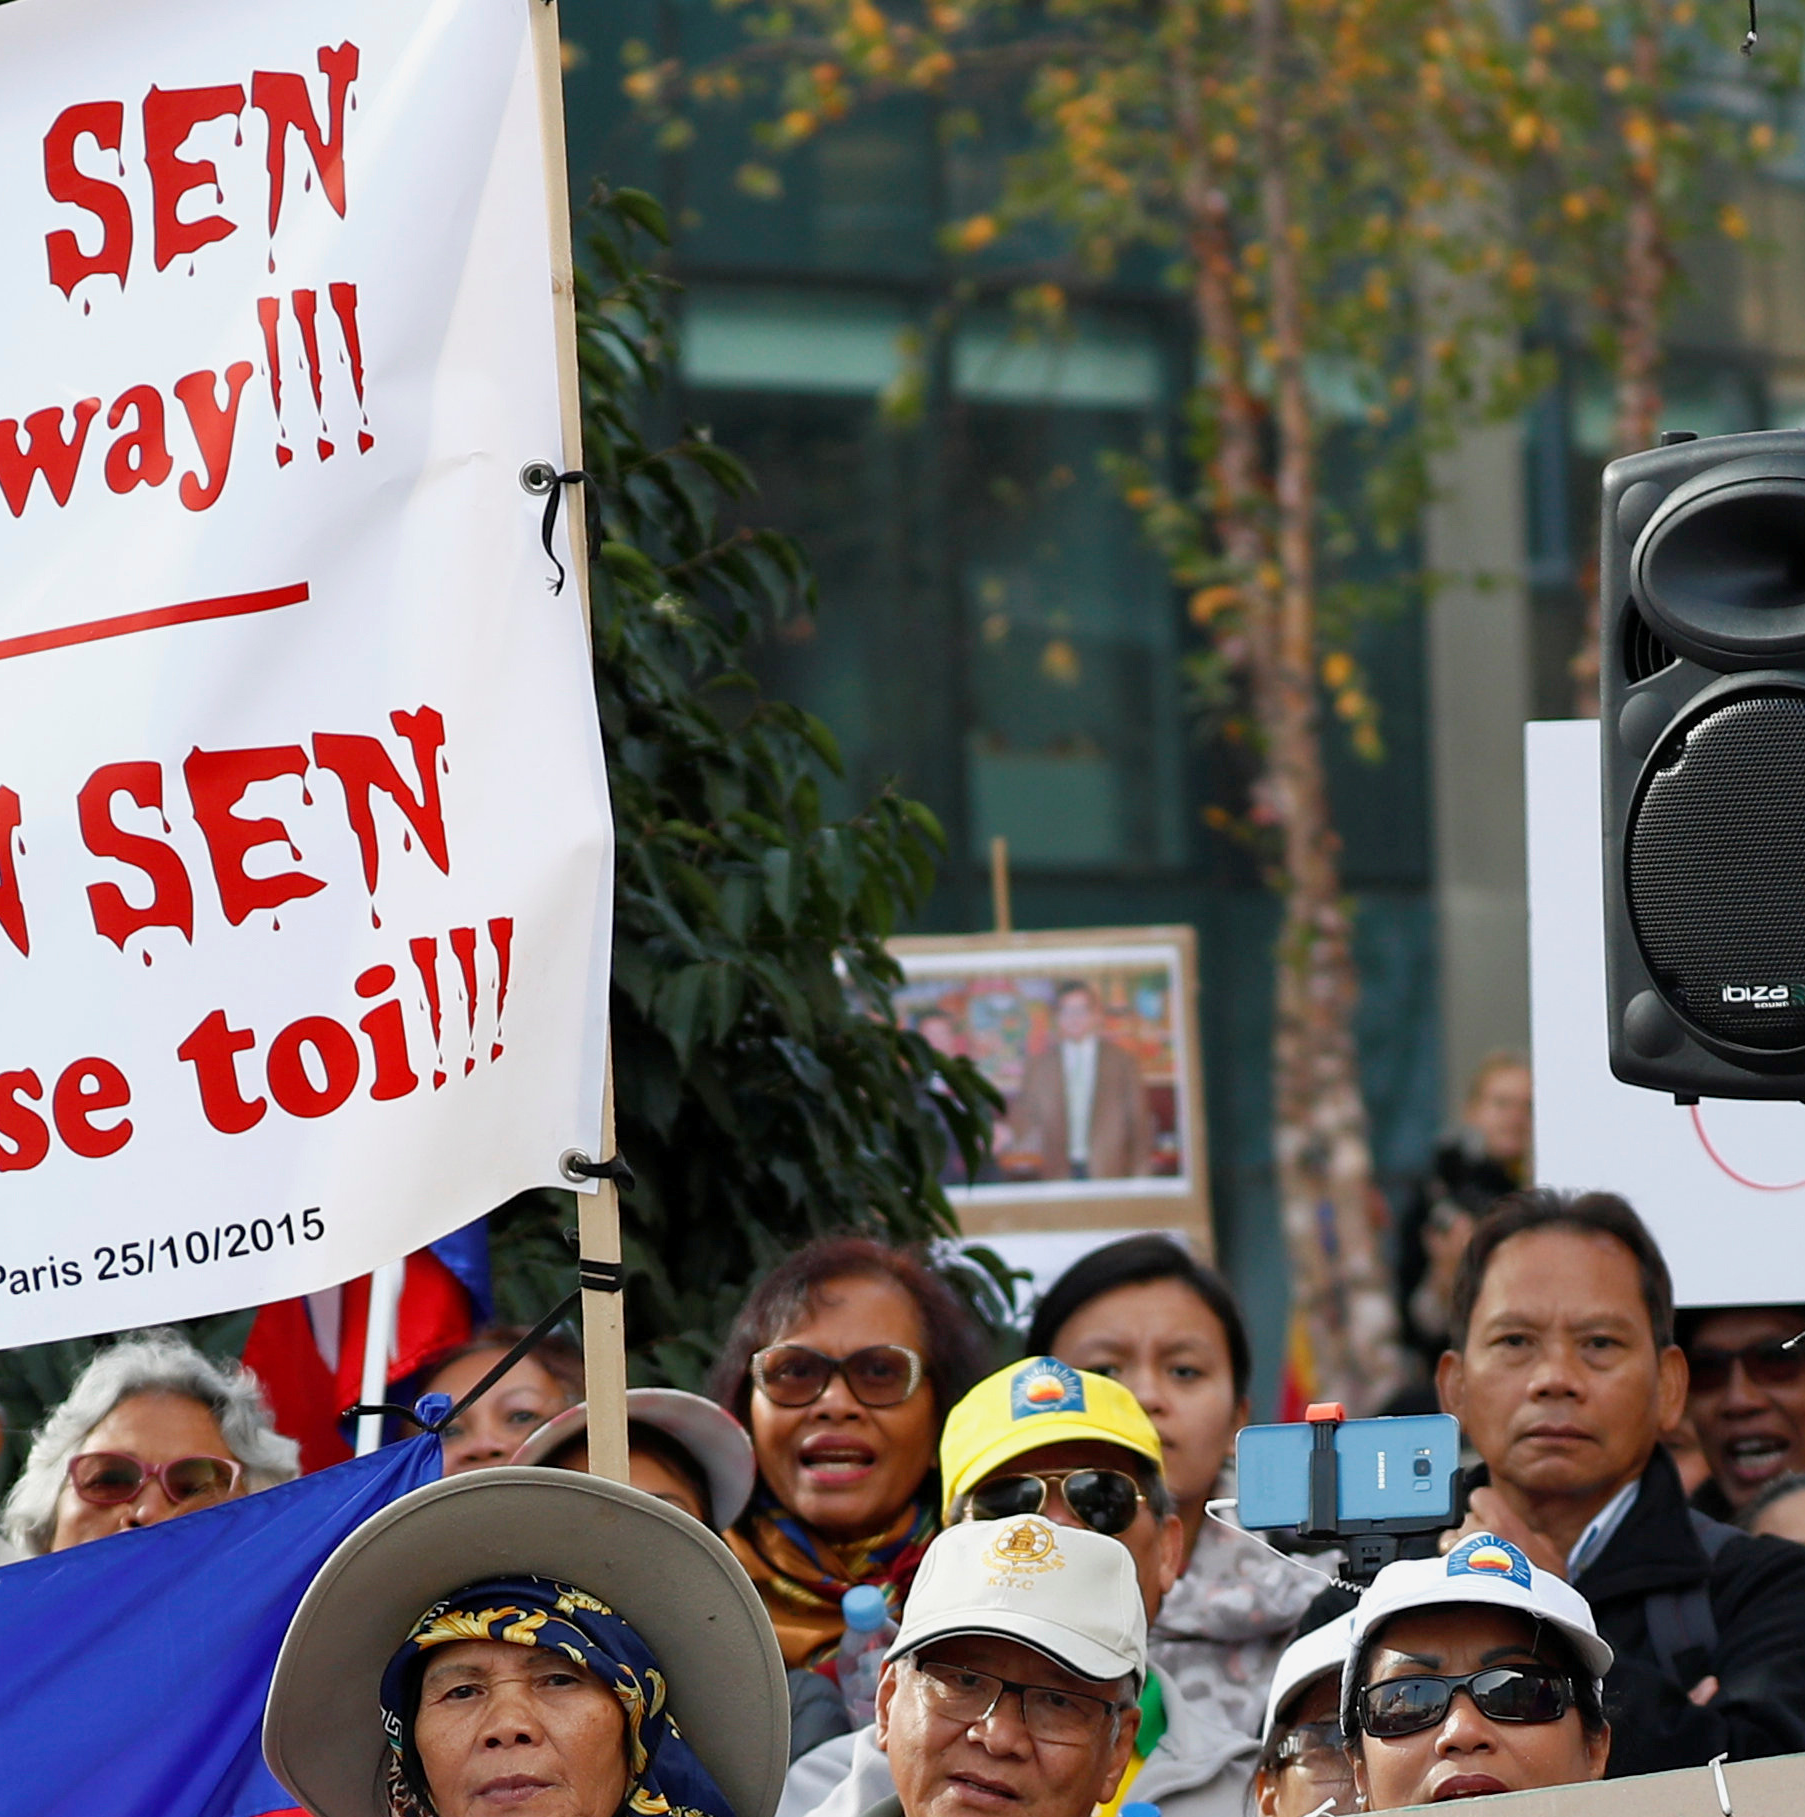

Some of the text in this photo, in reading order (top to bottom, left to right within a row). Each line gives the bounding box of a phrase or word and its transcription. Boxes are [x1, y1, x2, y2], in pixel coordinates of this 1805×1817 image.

[43, 39, 359, 316] SEN
[77, 704, 450, 967] SEN
[177, 917, 514, 1134] toi!!!
[94, 1207, 326, 1283] 25/10/2015
